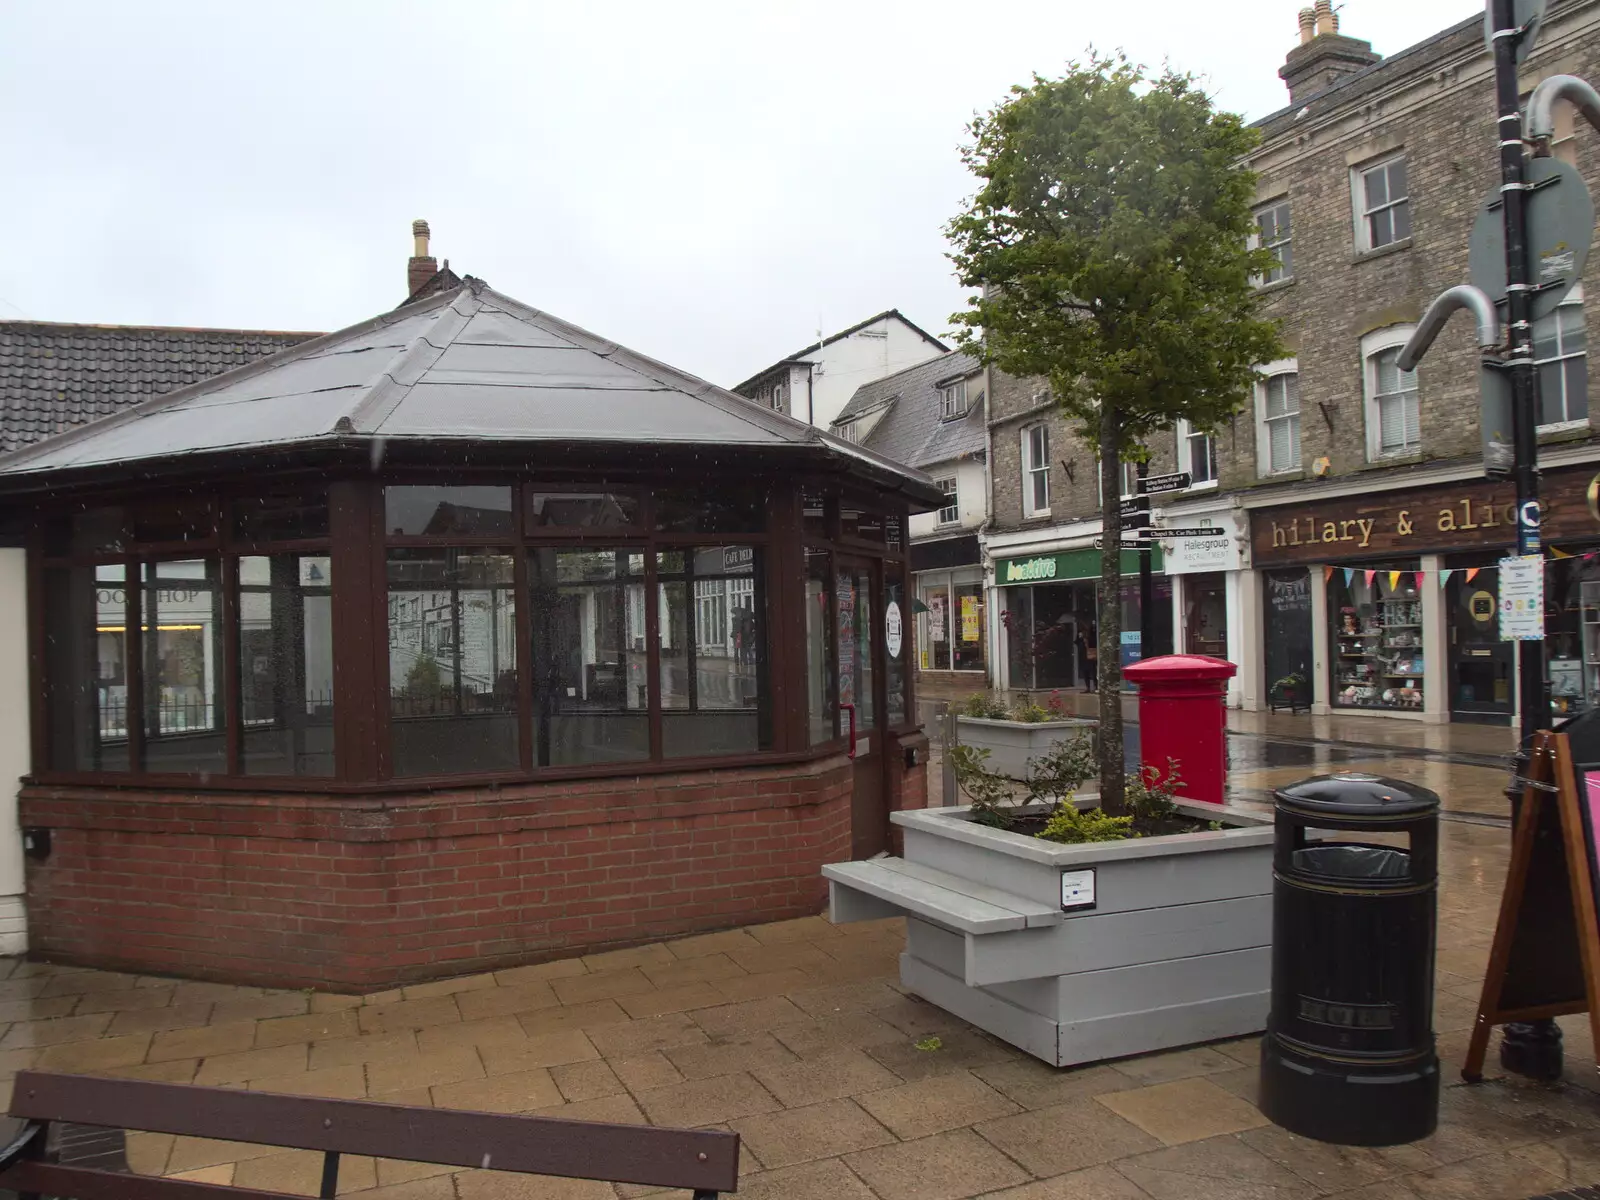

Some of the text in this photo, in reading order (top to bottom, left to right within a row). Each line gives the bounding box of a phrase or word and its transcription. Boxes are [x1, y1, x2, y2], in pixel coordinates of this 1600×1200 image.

[1150, 530, 1168, 538] Chapel
[1272, 517, 1375, 548] hilary
[1397, 510, 1413, 536] &
[1184, 538, 1229, 551] Halesgroup
[97, 589, 199, 605] OO HOP
